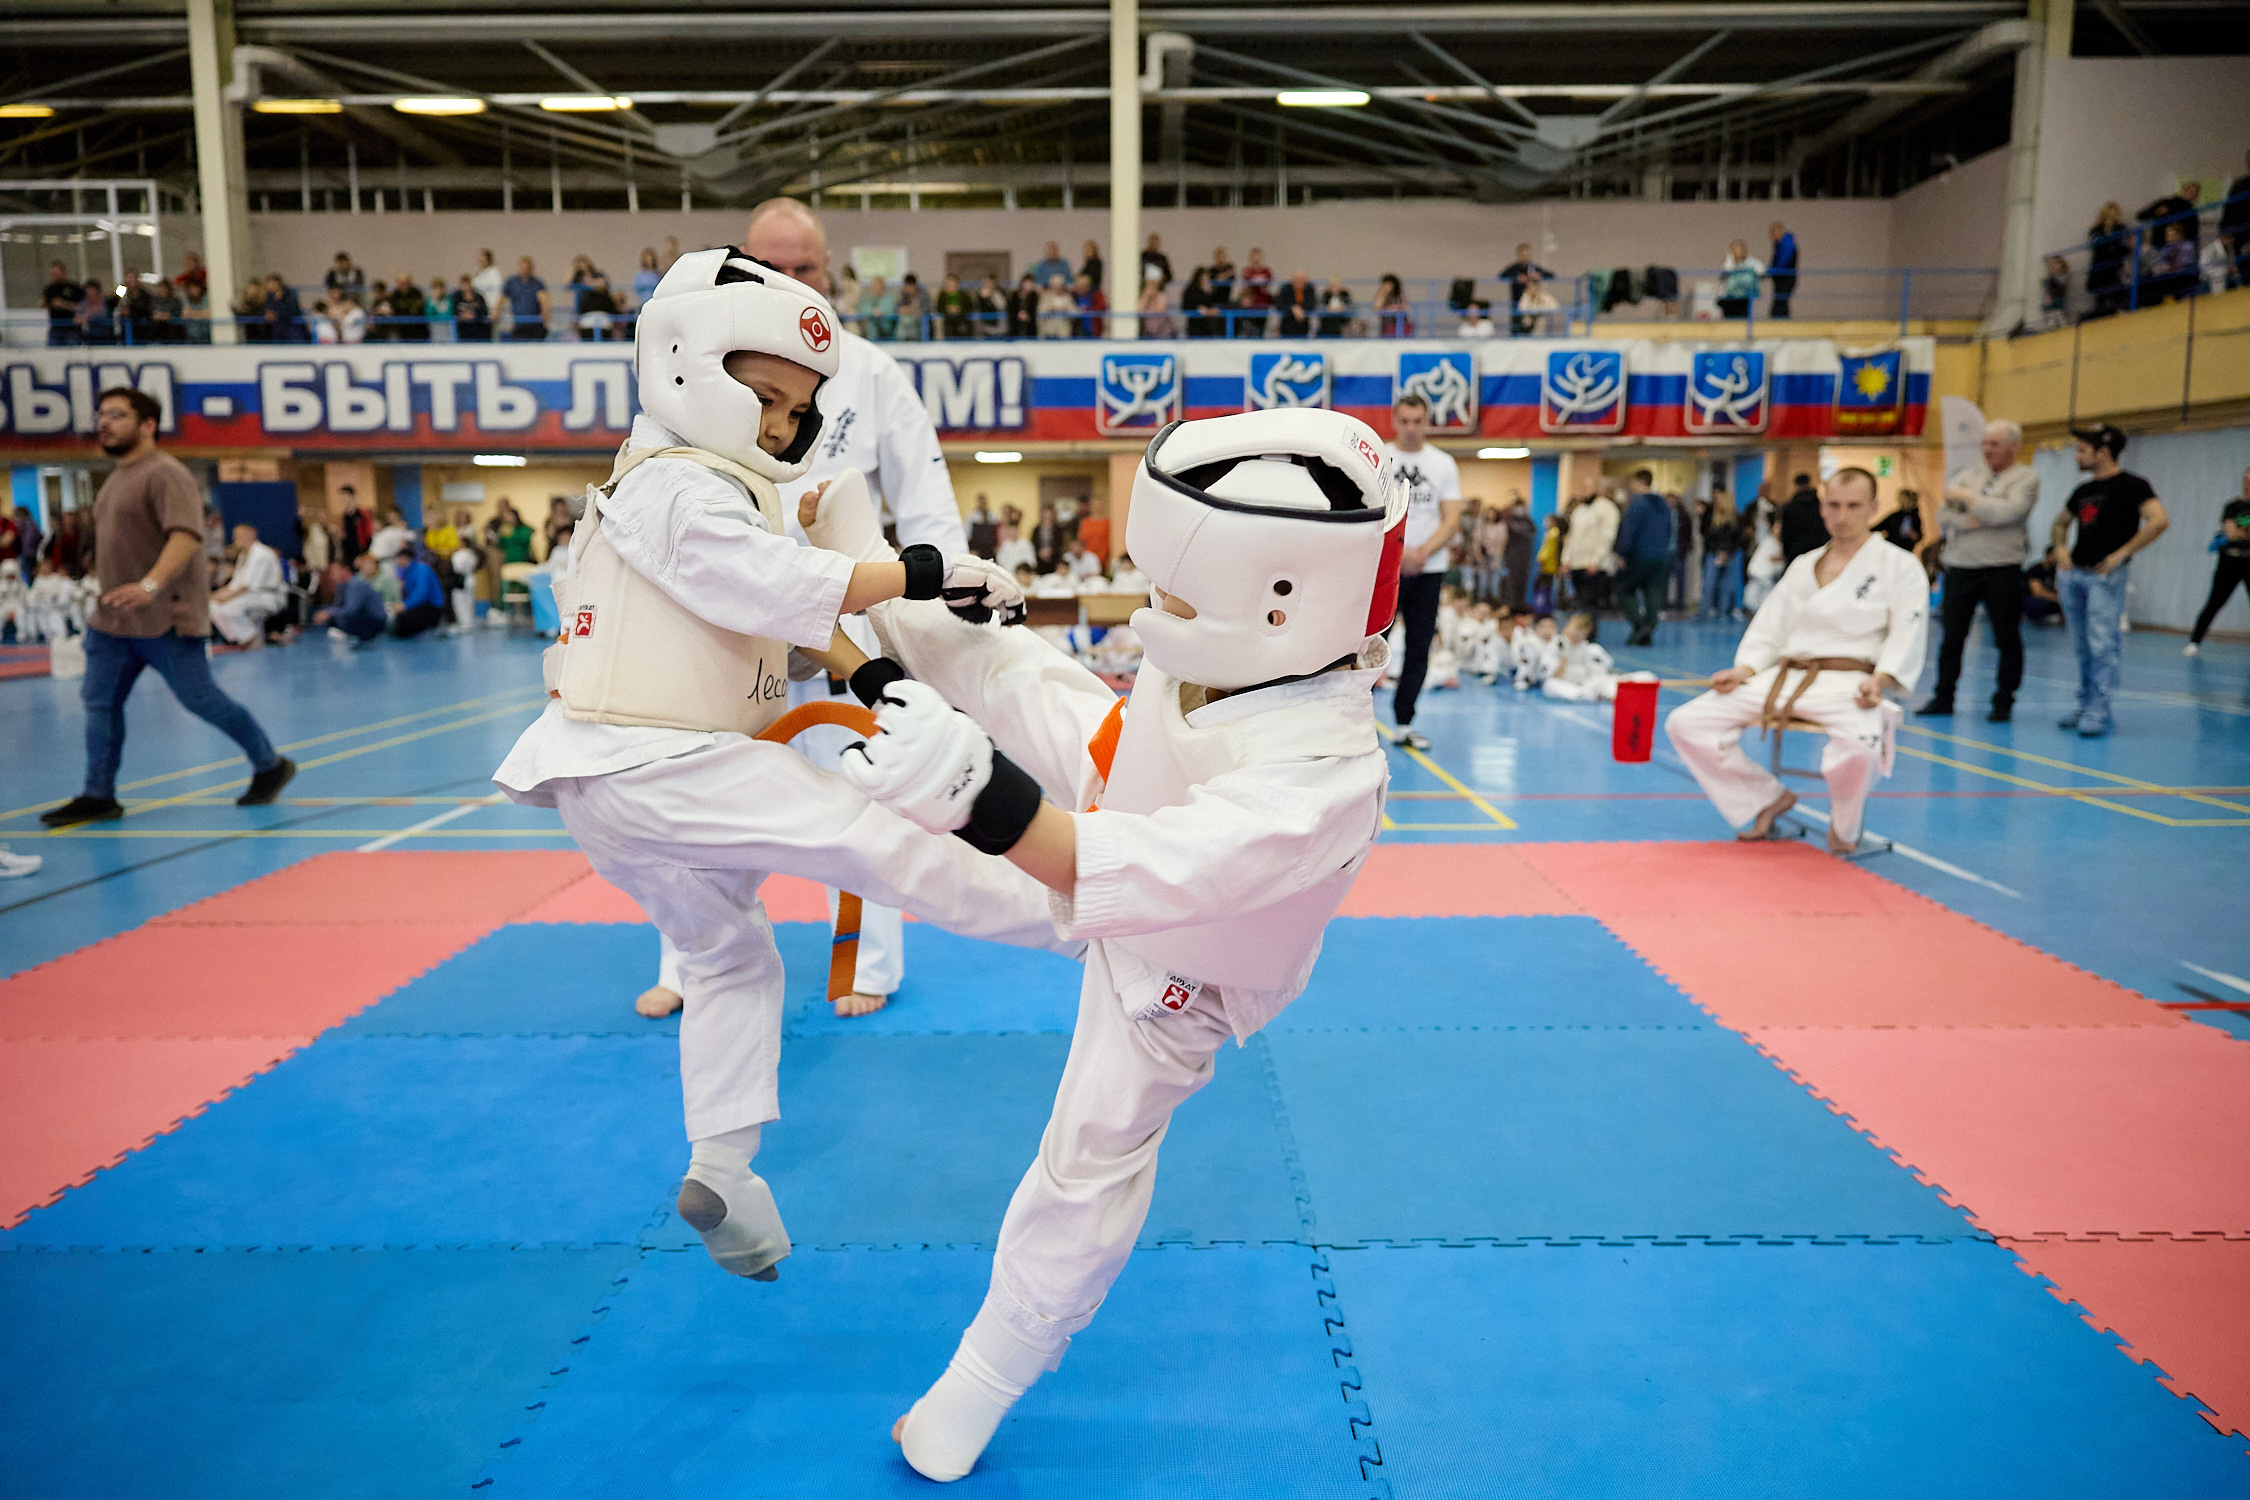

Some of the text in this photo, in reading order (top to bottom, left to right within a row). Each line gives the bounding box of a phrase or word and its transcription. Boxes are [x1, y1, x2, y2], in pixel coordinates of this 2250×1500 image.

[0, 362, 176, 434] ЫМ
[259, 360, 538, 433] БЫТЬ
[1169, 975, 1197, 992] АРХАТ
